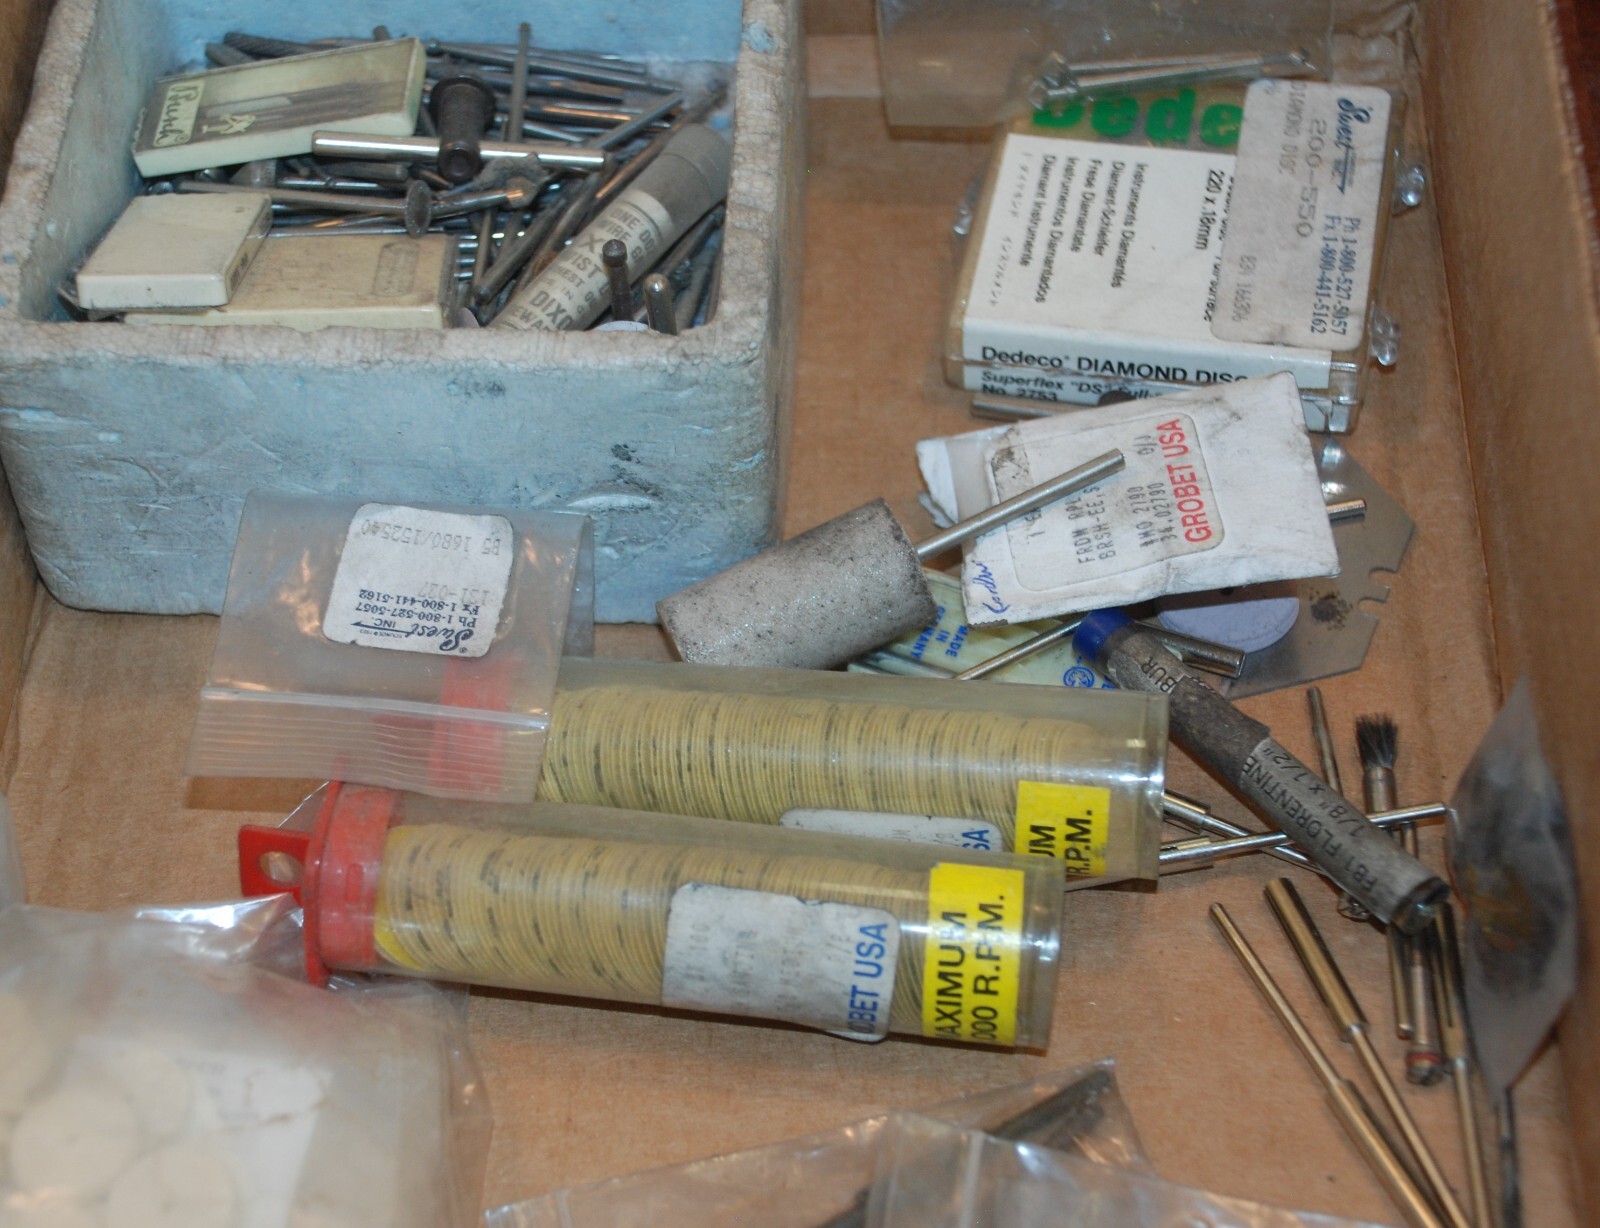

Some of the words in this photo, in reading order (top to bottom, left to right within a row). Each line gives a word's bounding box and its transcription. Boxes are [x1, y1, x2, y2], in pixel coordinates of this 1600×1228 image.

[1036, 154, 1056, 202] Diamant
[1052, 156, 1080, 228] Instrumentos
[1205, 167, 1226, 195] 220
[1296, 118, 1327, 239] 200-550
[1094, 161, 1126, 256] Diamant-Schleifer
[1019, 201, 1046, 267] Instrumente
[1034, 229, 1063, 304] Diamantados
[1309, 236, 1338, 335] 1-800-441-5162
[1331, 237, 1357, 336] 1-800-527-5057
[981, 346, 1065, 368] Dedeco
[1077, 355, 1187, 382] DIAMOND
[981, 370, 1064, 391] Superflex
[1156, 417, 1190, 460] USA
[1165, 464, 1213, 544] GROBET
[355, 601, 453, 625] 1-800-527-5057
[358, 588, 457, 613] 1-800-441-5162
[371, 616, 396, 630] INC.
[458, 615, 478, 629] Ph
[461, 602, 480, 617] Fx
[405, 623, 474, 651] Swest
[935, 628, 951, 643] IN
[945, 624, 969, 658] MADE
[1241, 755, 1341, 857] FLORENTINE
[852, 921, 890, 981] USA
[972, 893, 1007, 996] R.P.M.
